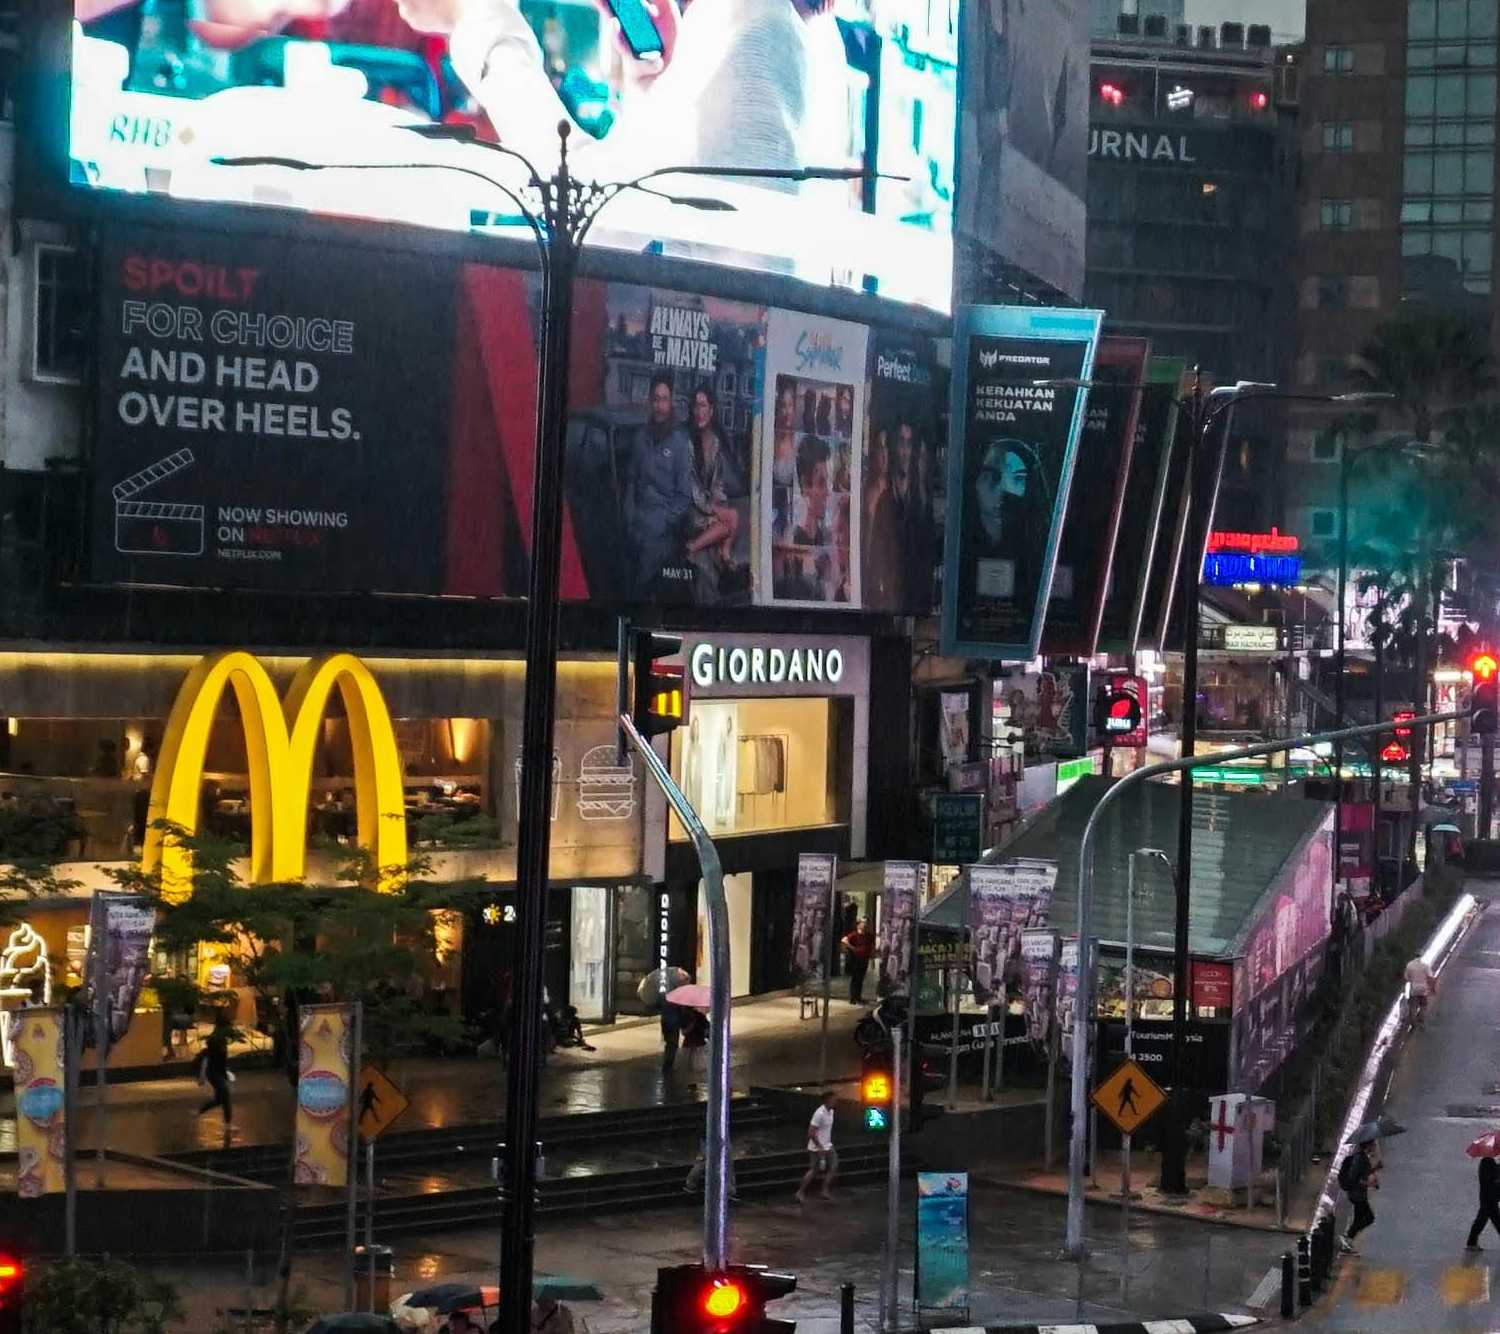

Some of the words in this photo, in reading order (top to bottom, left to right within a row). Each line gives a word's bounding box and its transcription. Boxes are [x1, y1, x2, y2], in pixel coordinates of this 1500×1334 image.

[110, 115, 172, 148] RHB
[124, 257, 260, 299] SPOILT
[123, 300, 204, 341] FOR
[211, 309, 355, 353] CHOICE
[650, 306, 710, 341] ALWAYS
[666, 337, 718, 371] MAYBE
[877, 355, 911, 382] Perfect
[998, 355, 1051, 366] PREDATOR
[120, 347, 206, 384] AND
[216, 355, 320, 393] HEAD
[975, 384, 1055, 399] KERAHKAN
[975, 398, 1053, 412] KEKUATAN
[118, 391, 226, 432] OVER
[235, 400, 361, 441] HEELS.
[974, 409, 1017, 422] ANDA
[217, 506, 262, 524] NOW
[266, 509, 349, 528] SHOWING
[217, 526, 245, 542] ON
[662, 567, 681, 579] MAY
[683, 568, 693, 580] 31
[692, 642, 843, 687] GIORDANO
